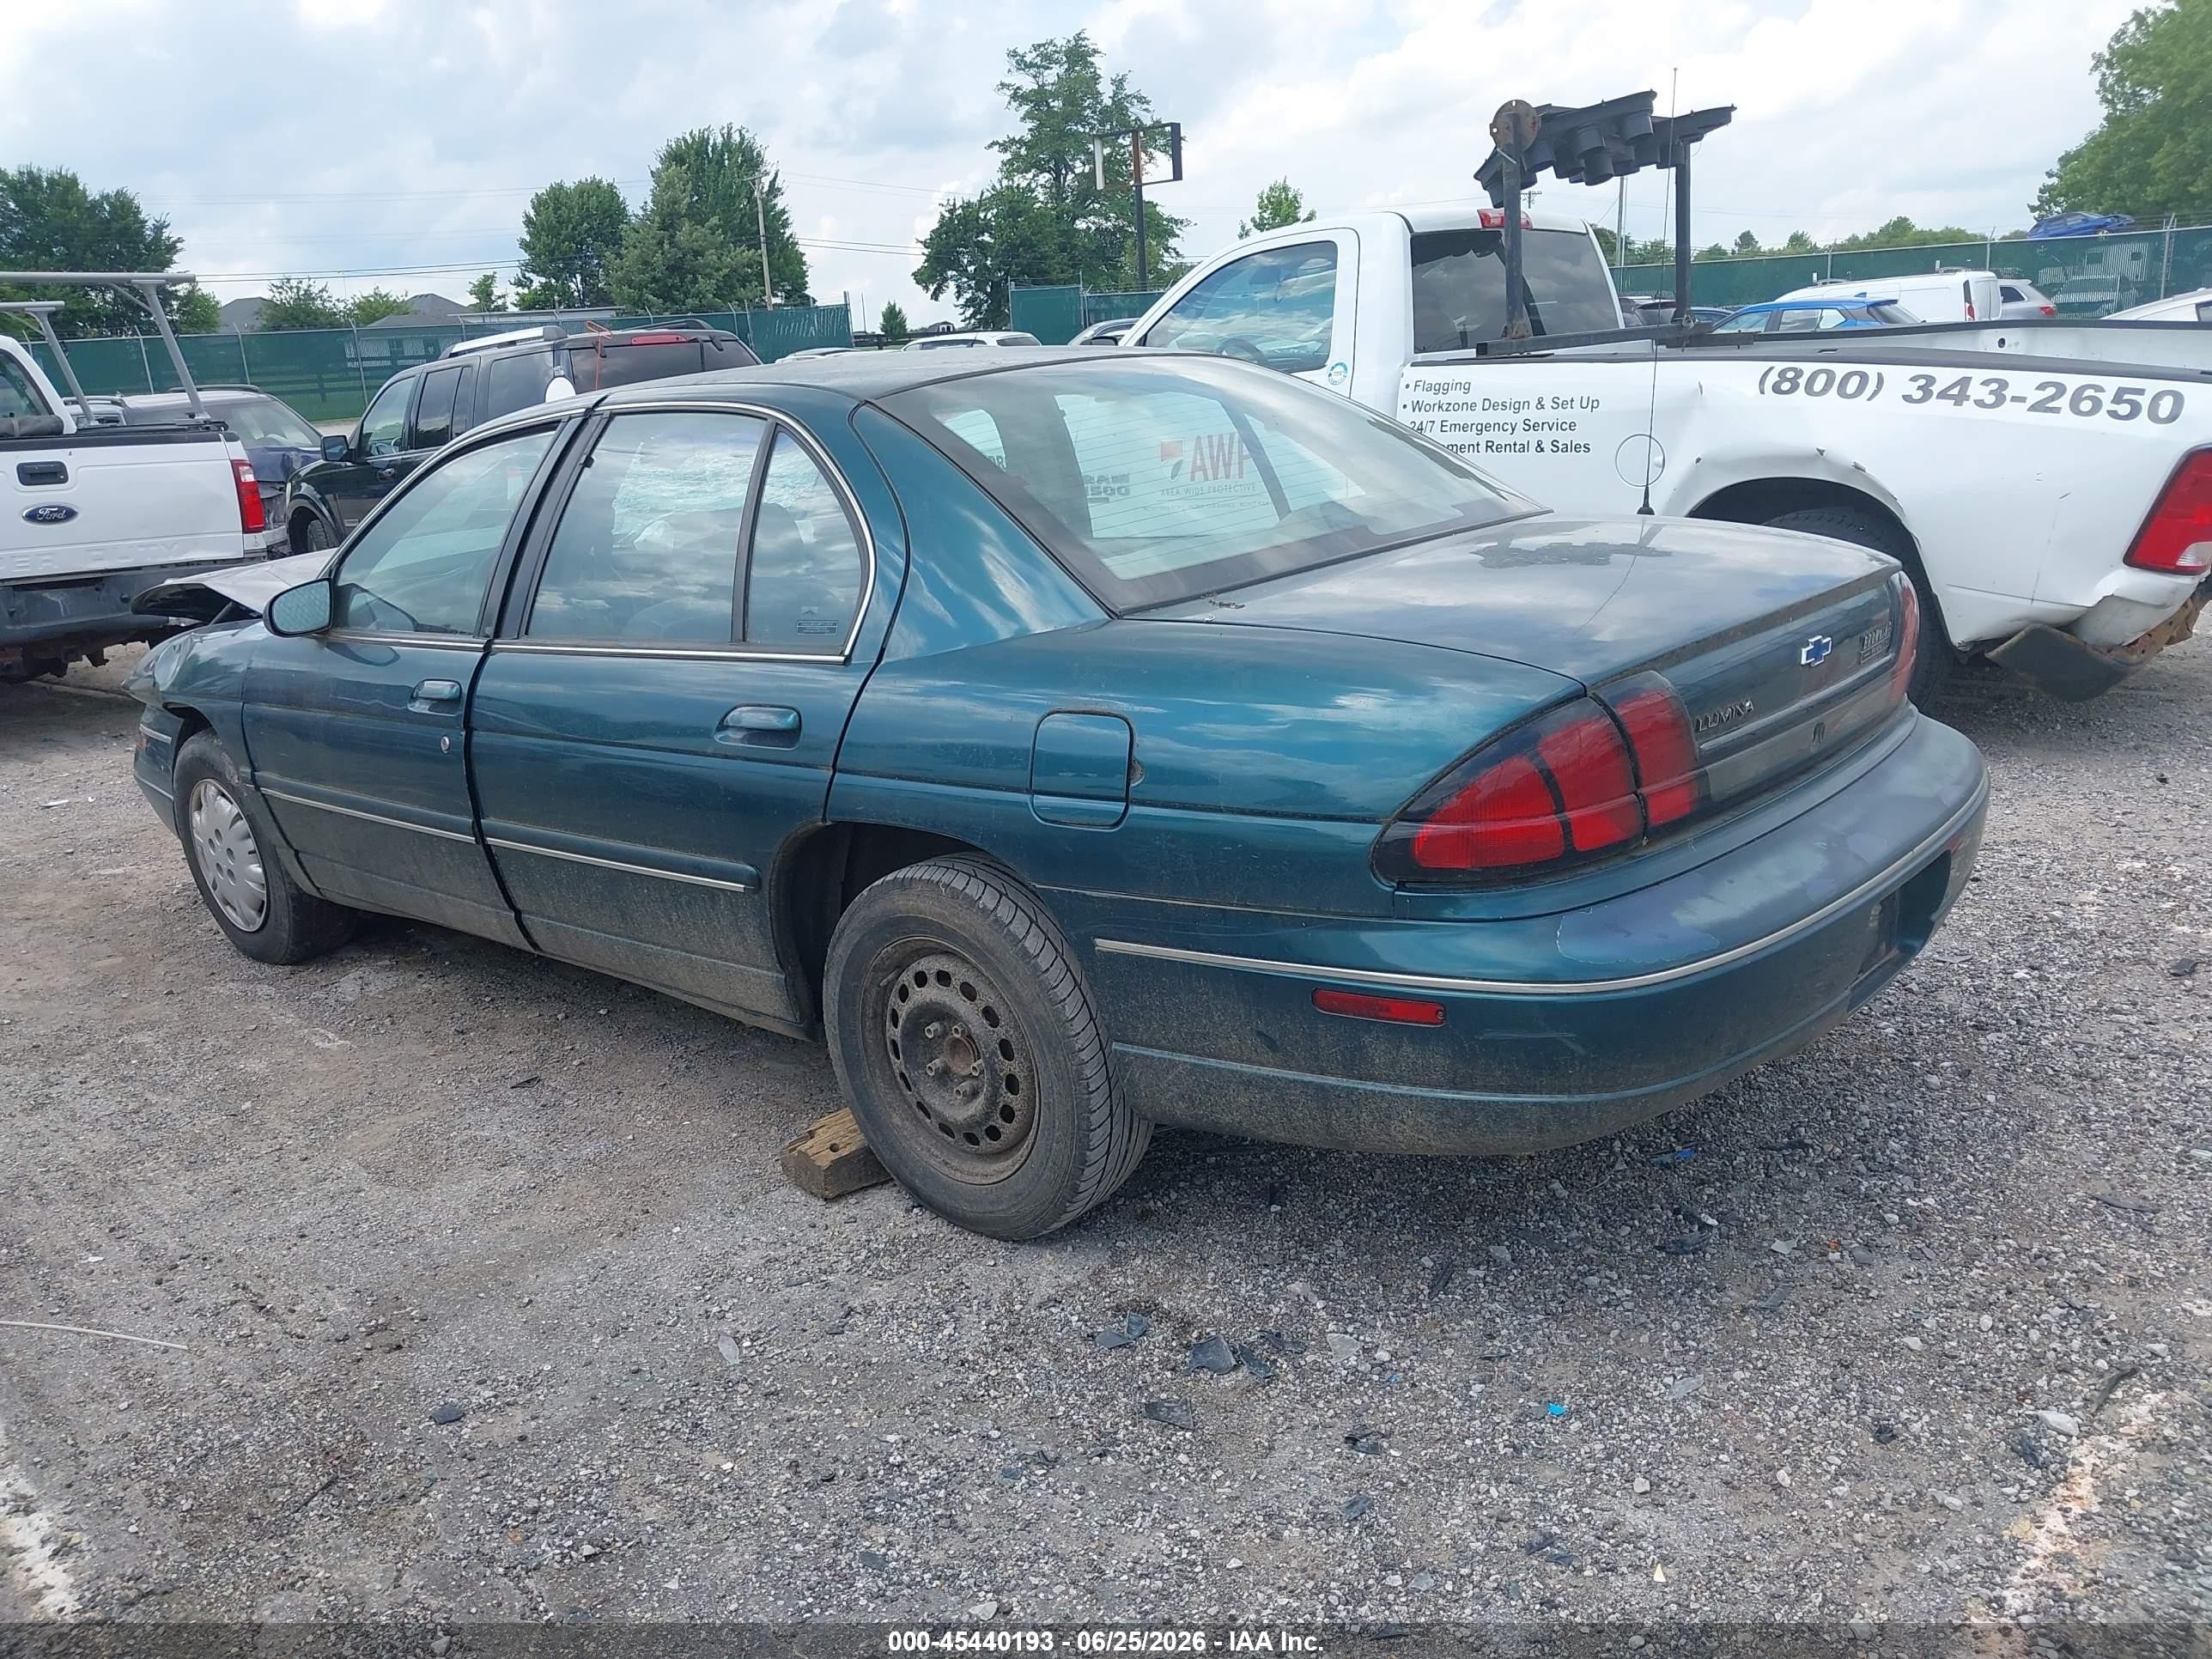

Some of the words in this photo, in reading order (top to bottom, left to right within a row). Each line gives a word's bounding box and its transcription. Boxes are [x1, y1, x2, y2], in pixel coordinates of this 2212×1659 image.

[1413, 380, 1471, 395] Flagging
[1759, 366, 1885, 401] (800)
[1902, 374, 2185, 424] 343-2650
[1412, 400, 1477, 412] Workzone
[1482, 398, 1530, 414] Design
[1535, 397, 1546, 410] &
[1551, 397, 1575, 410] Set
[1579, 396, 1600, 412] Up
[1409, 420, 1436, 434] 24/7
[1440, 420, 1517, 435] Emergency
[1522, 418, 1577, 432] Service
[1485, 440, 1529, 453] Rental
[1534, 440, 1545, 453] &
[1551, 440, 1591, 453] Sales
[1183, 486, 1203, 495] WIDE
[37, 507, 67, 520] Ford
[1696, 700, 1754, 732] LUMINA
